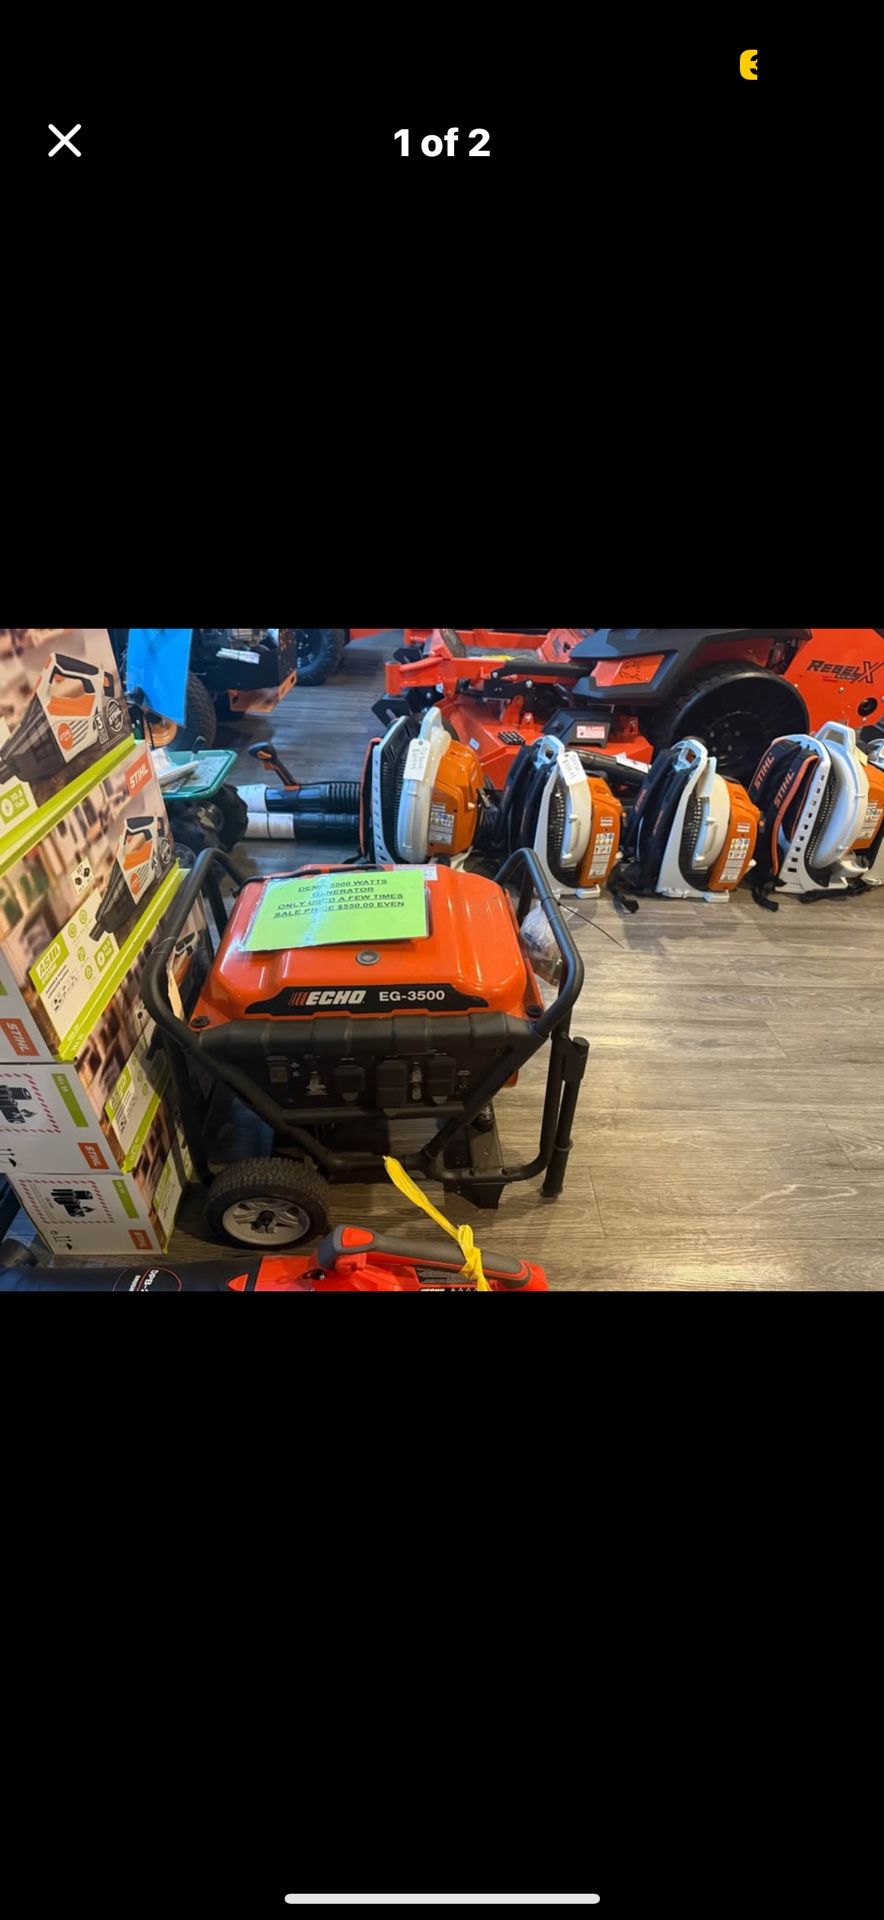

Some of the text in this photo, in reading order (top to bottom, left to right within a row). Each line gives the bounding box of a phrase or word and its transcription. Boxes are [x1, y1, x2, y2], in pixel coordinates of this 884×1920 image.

[129, 763, 149, 789] STIHL
[753, 752, 775, 791] STIHL
[774, 768, 795, 806] STIHL
[353, 878, 388, 887] WATTS
[274, 909, 302, 919] SALE
[338, 901, 375, 911] $550.00
[377, 900, 405, 909] EVEN
[278, 900, 306, 910] ONLY
[348, 894, 372, 902] FEW
[305, 990, 445, 1006] ECHO EG-3500
[7, 1021, 29, 1052] STIHL
[141, 1269, 160, 1292] DPB-
